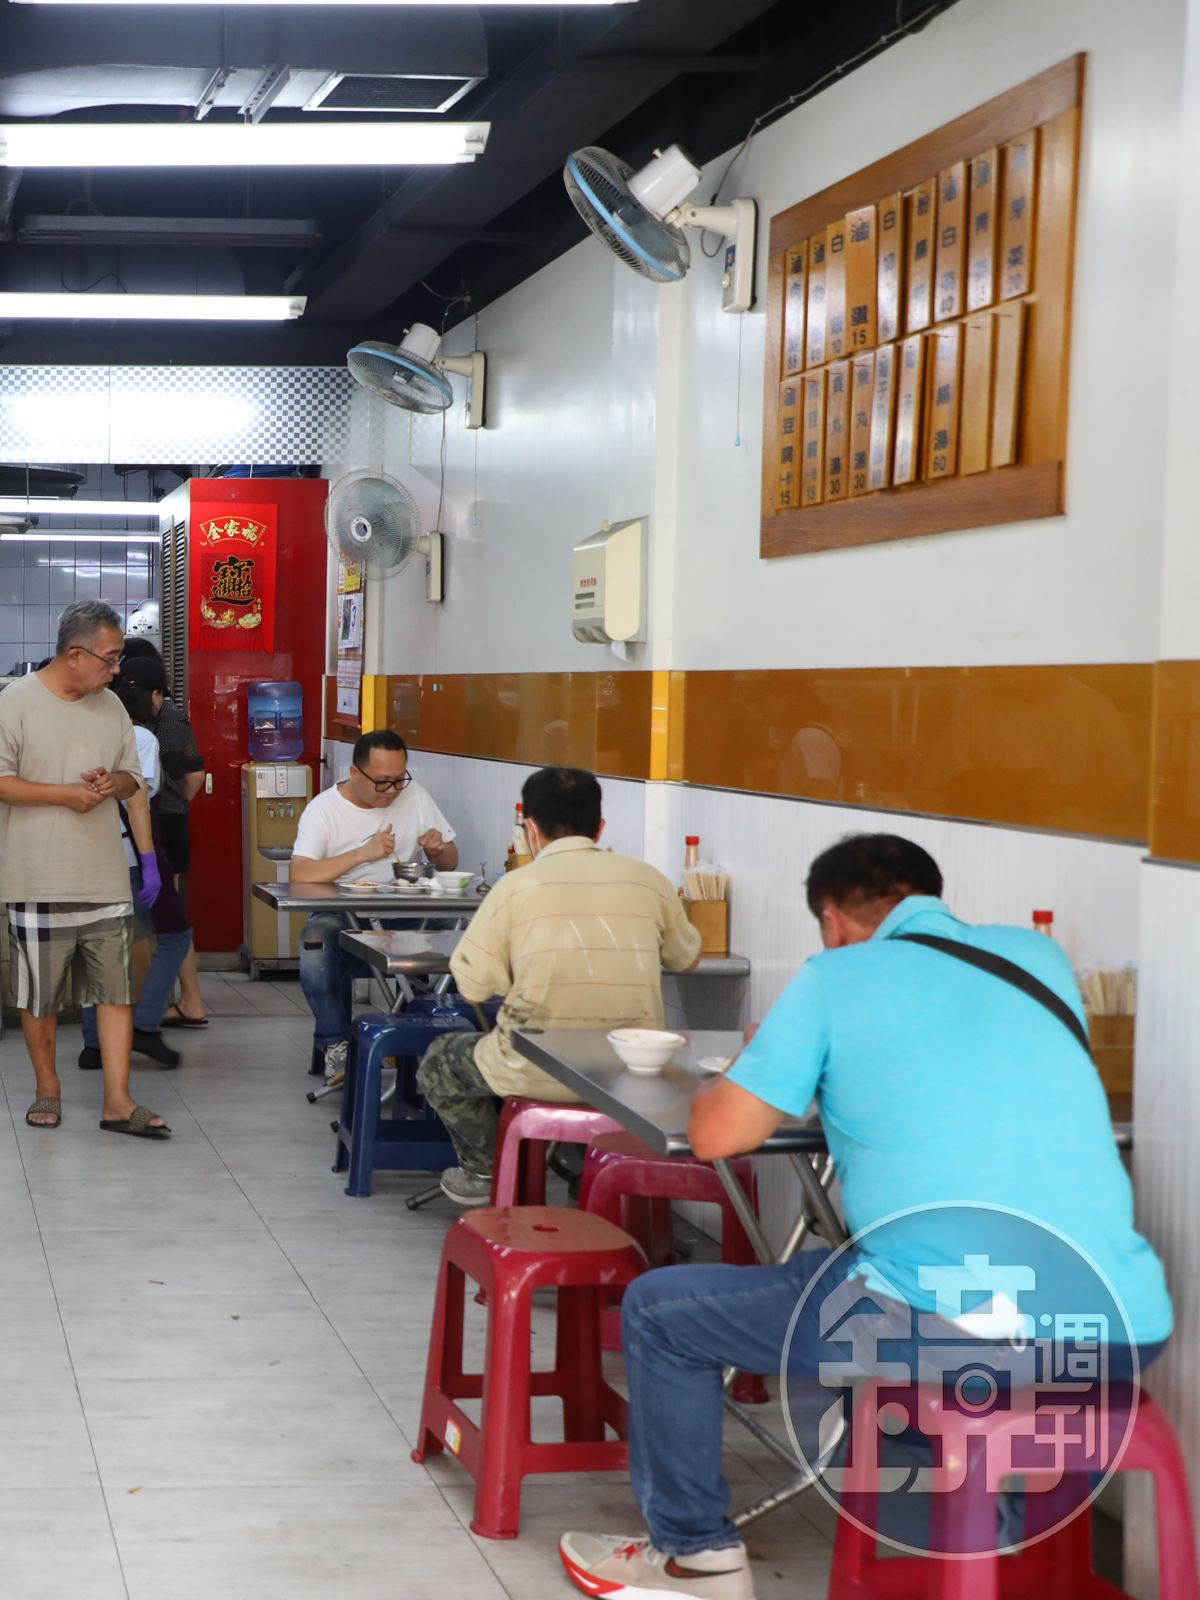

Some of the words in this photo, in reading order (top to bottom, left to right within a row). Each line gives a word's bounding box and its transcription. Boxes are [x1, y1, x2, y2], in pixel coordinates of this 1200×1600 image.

[852, 329, 867, 346] 15
[830, 479, 841, 495] 30
[853, 474, 866, 490] 30
[781, 490, 791, 504] 15
[207, 519, 259, 542] 全家福
